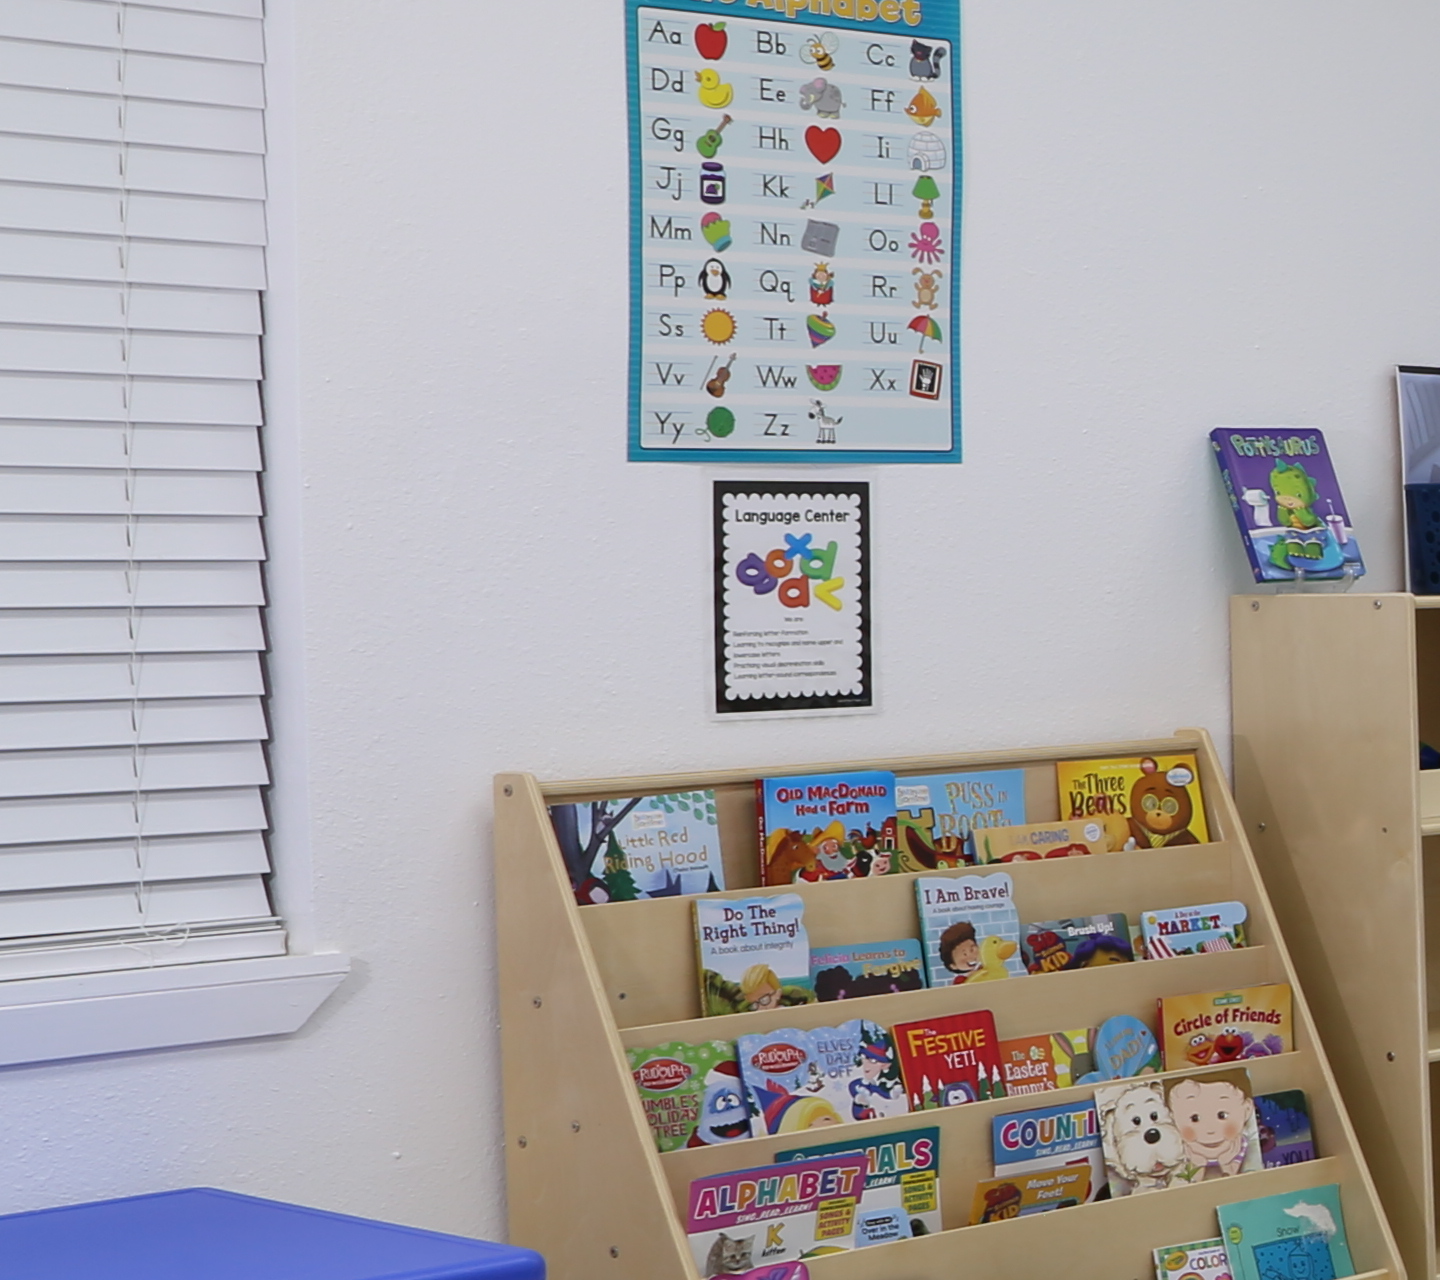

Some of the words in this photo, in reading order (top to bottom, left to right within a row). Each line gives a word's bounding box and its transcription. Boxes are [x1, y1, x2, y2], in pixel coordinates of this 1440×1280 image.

[648, 22, 682, 46] Aa
[756, 32, 787, 55] Bb
[866, 44, 895, 67] Cc
[651, 68, 684, 93] Dd
[759, 79, 786, 102] Ee
[870, 89, 896, 112] Ff
[651, 119, 684, 151] Gg
[759, 127, 789, 151] Hh
[877, 136, 890, 159] Ii
[656, 167, 683, 201] Jj
[762, 175, 789, 198] Kk
[874, 183, 894, 205] Ll
[650, 217, 692, 241] Mm
[760, 223, 791, 247] Nn
[869, 230, 899, 253] Oo
[659, 265, 686, 296] Pp
[759, 270, 795, 302] Qq
[872, 277, 897, 298] Rr
[659, 314, 684, 337] Ss
[765, 318, 787, 340] Tt
[870, 323, 897, 345] Uu
[657, 364, 685, 387] Vv
[756, 366, 797, 388] Ww
[870, 369, 897, 391] Xx
[655, 412, 684, 443] Yy
[764, 414, 790, 437] Zz
[735, 509, 800, 525] Language
[805, 509, 850, 522] Center
[1072, 779, 1087, 790] The
[1084, 773, 1125, 794] Three
[795, 802, 818, 816] Had
[820, 804, 826, 813] a
[828, 799, 870, 816] Farm
[944, 781, 994, 815] PUSS
[999, 791, 1008, 803] IN
[1069, 791, 1127, 817] Bears
[617, 834, 654, 850] Little
[658, 827, 689, 847] Red
[1030, 829, 1070, 845] CARING
[603, 854, 655, 875] Riding
[659, 845, 708, 868] Hood
[924, 889, 931, 905] I
[936, 888, 960, 904] Am
[963, 882, 1010, 901] Brave!
[723, 908, 744, 922] Do
[747, 905, 776, 920] The
[952, 905, 966, 913] about
[702, 925, 747, 944] Right
[750, 918, 800, 938] Thing!
[1067, 924, 1096, 937] Brush
[1098, 922, 1114, 936] Up!
[1157, 915, 1221, 936] MARKET
[710, 947, 717, 955] A
[718, 945, 739, 955] book
[740, 943, 762, 953] about
[764, 941, 794, 952] integrity
[852, 951, 892, 962] Learns
[894, 948, 906, 957] to
[1040, 951, 1069, 972] KID
[1173, 1014, 1212, 1036] Circle
[1215, 1008, 1229, 1023] of
[1232, 1006, 1282, 1025] Friends
[817, 1038, 854, 1051] ELVES
[906, 1028, 987, 1058] FESTIVE
[1109, 1035, 1143, 1070] DAD!
[826, 1055, 851, 1065] DAY
[944, 1049, 977, 1070] YETI
[1011, 1050, 1025, 1061] The
[828, 1065, 853, 1079] OFF
[1004, 1060, 1050, 1081] Easter
[643, 1094, 699, 1112] UMBLE'S
[653, 1123, 688, 1139] TREE
[1000, 1108, 1100, 1150] COUNTI
[1026, 1178, 1055, 1190] Move
[1056, 1172, 1079, 1185] Your
[694, 1168, 860, 1220] ALPHABET
[1036, 1188, 1064, 1201] Feet!
[766, 1222, 785, 1248] K
[1276, 1226, 1300, 1237] Snow
[1189, 1252, 1228, 1271] COLOR
